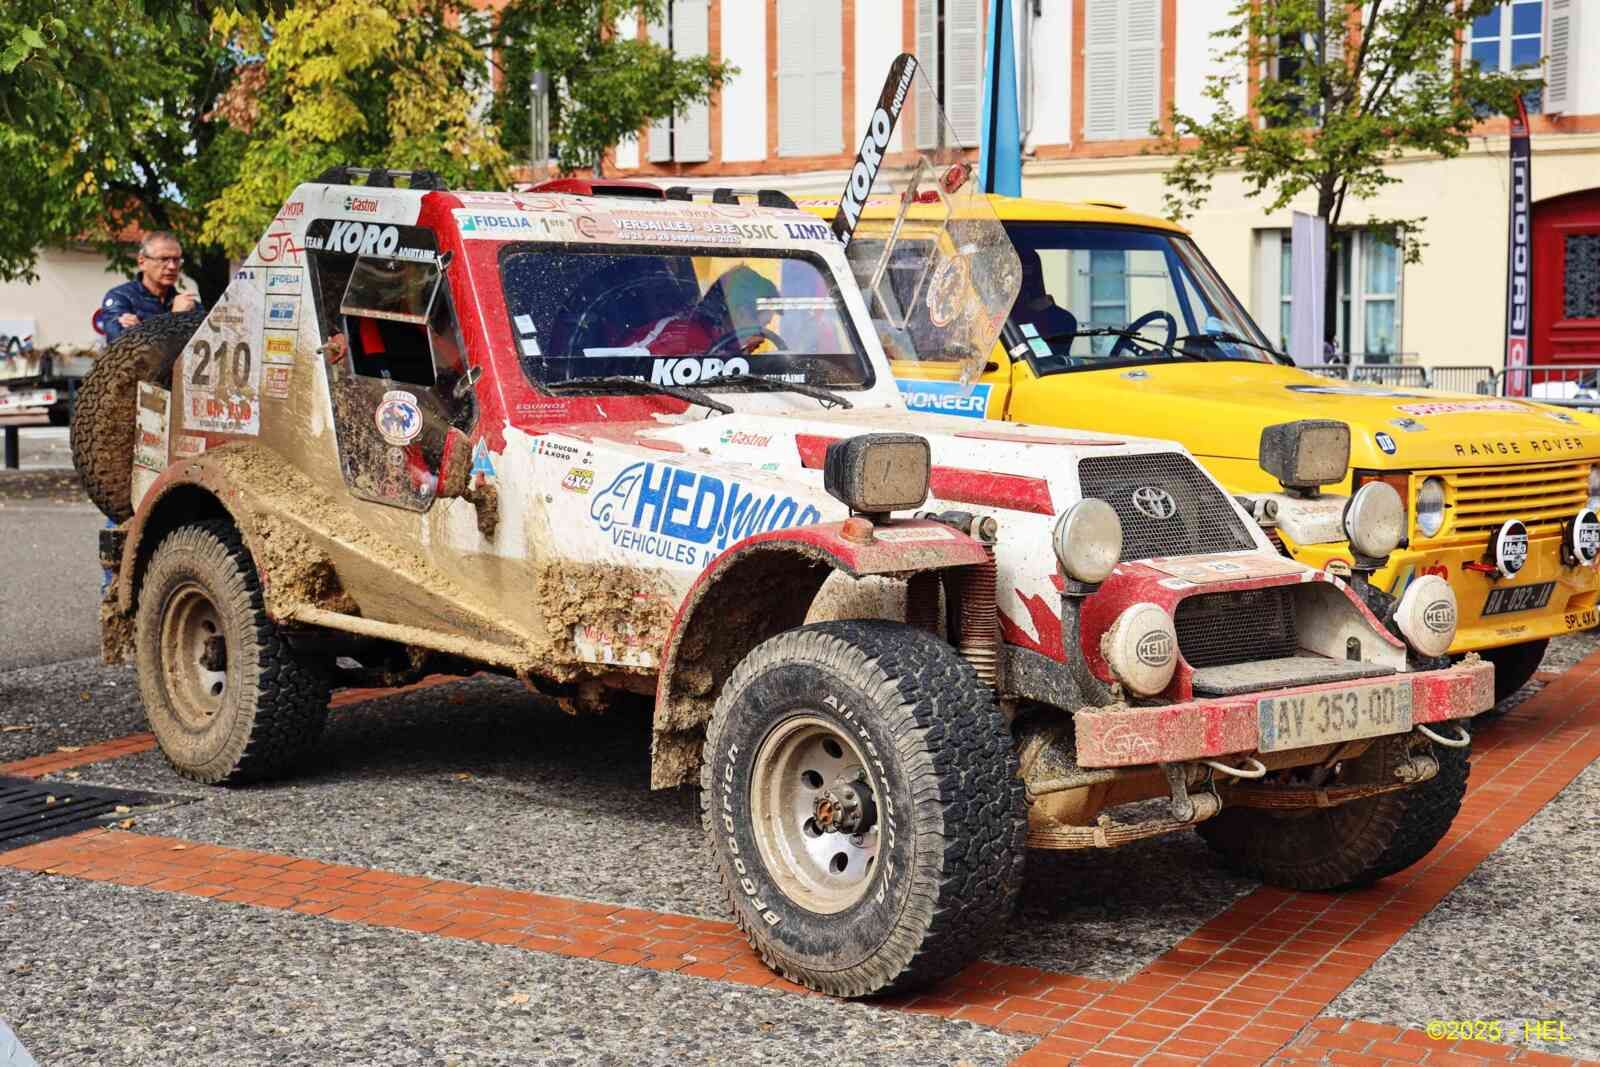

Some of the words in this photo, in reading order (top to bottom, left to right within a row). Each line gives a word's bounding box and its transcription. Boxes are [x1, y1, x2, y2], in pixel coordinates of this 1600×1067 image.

[841, 108, 890, 229] KORO
[890, 56, 917, 117] AQUITAINE
[352, 197, 378, 215] Castrol
[474, 215, 532, 229] FIDELIA
[305, 236, 323, 249] TEAM
[325, 221, 399, 256] KORO
[191, 339, 252, 388] 210
[651, 357, 750, 386] KORO
[731, 431, 773, 448] Castrol
[1454, 441, 1521, 457] RANGE
[1531, 437, 1584, 453] ROVER
[611, 527, 697, 566] VEHICULES
[722, 743, 782, 927] BFGoodrich
